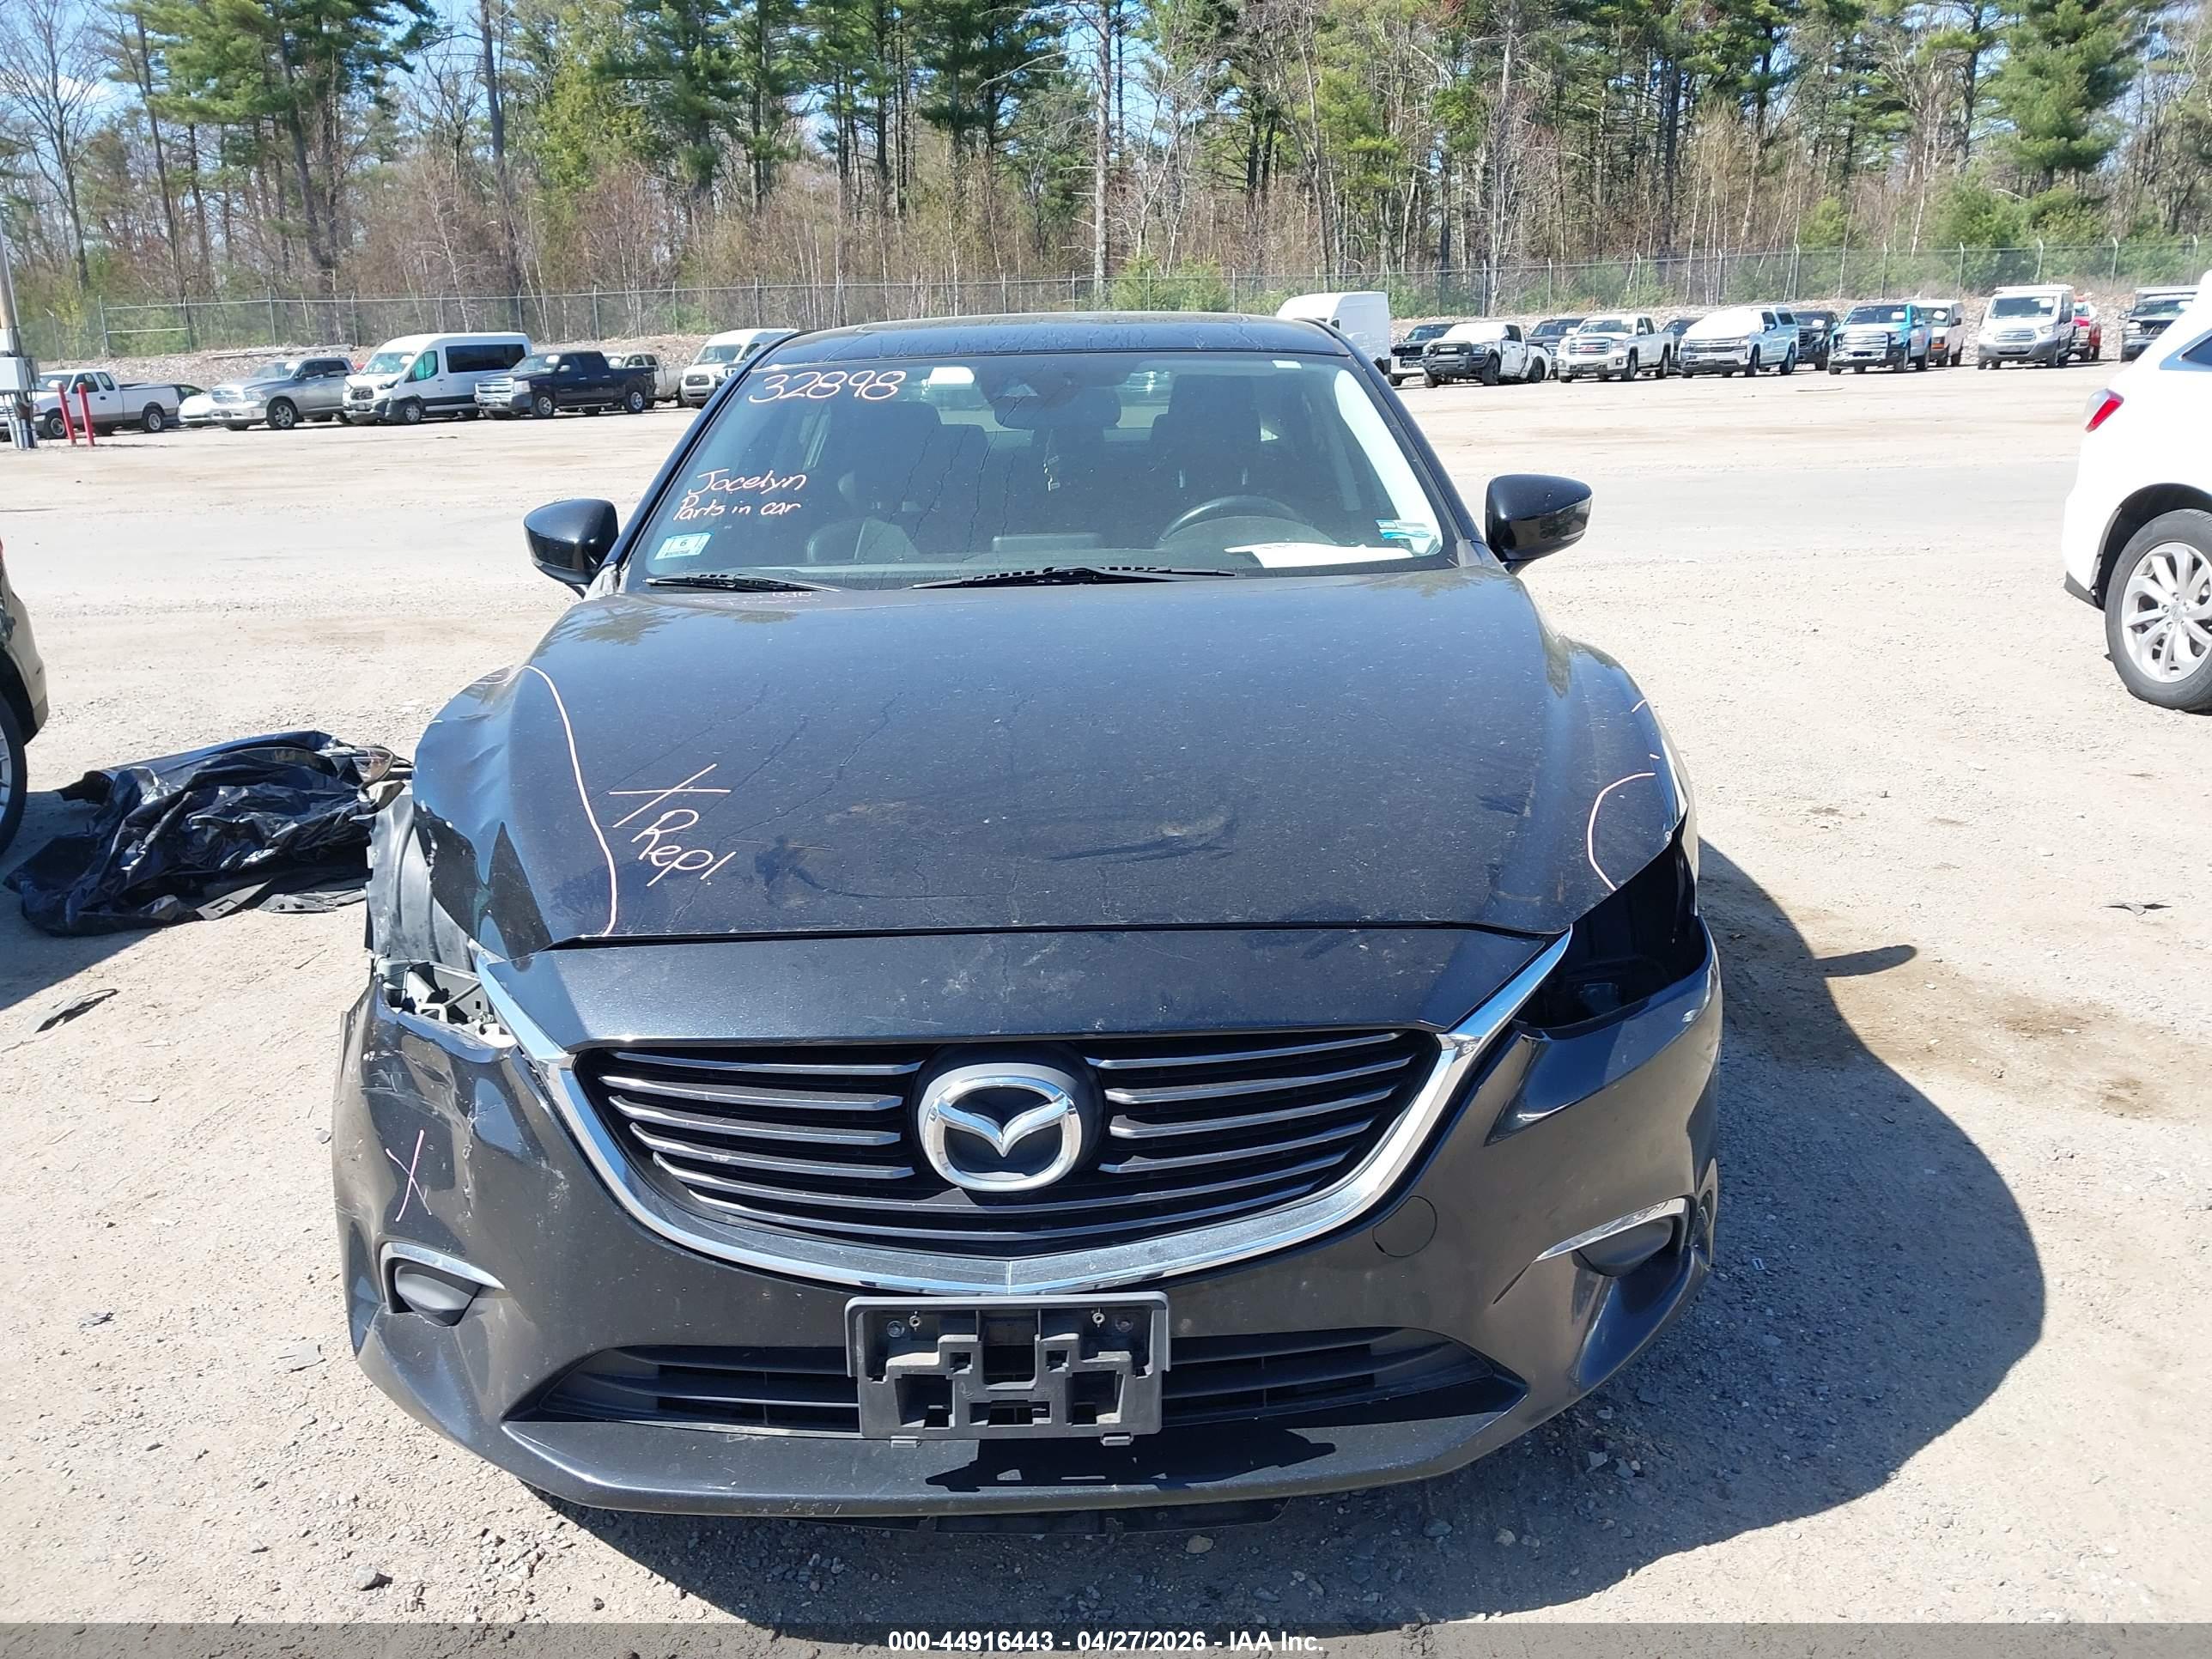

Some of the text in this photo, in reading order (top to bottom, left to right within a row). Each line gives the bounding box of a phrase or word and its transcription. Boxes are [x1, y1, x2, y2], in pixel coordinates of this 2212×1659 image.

[748, 369, 907, 403] 32898
[687, 468, 807, 495] Jocelyn
[672, 494, 802, 521] Parts in car
